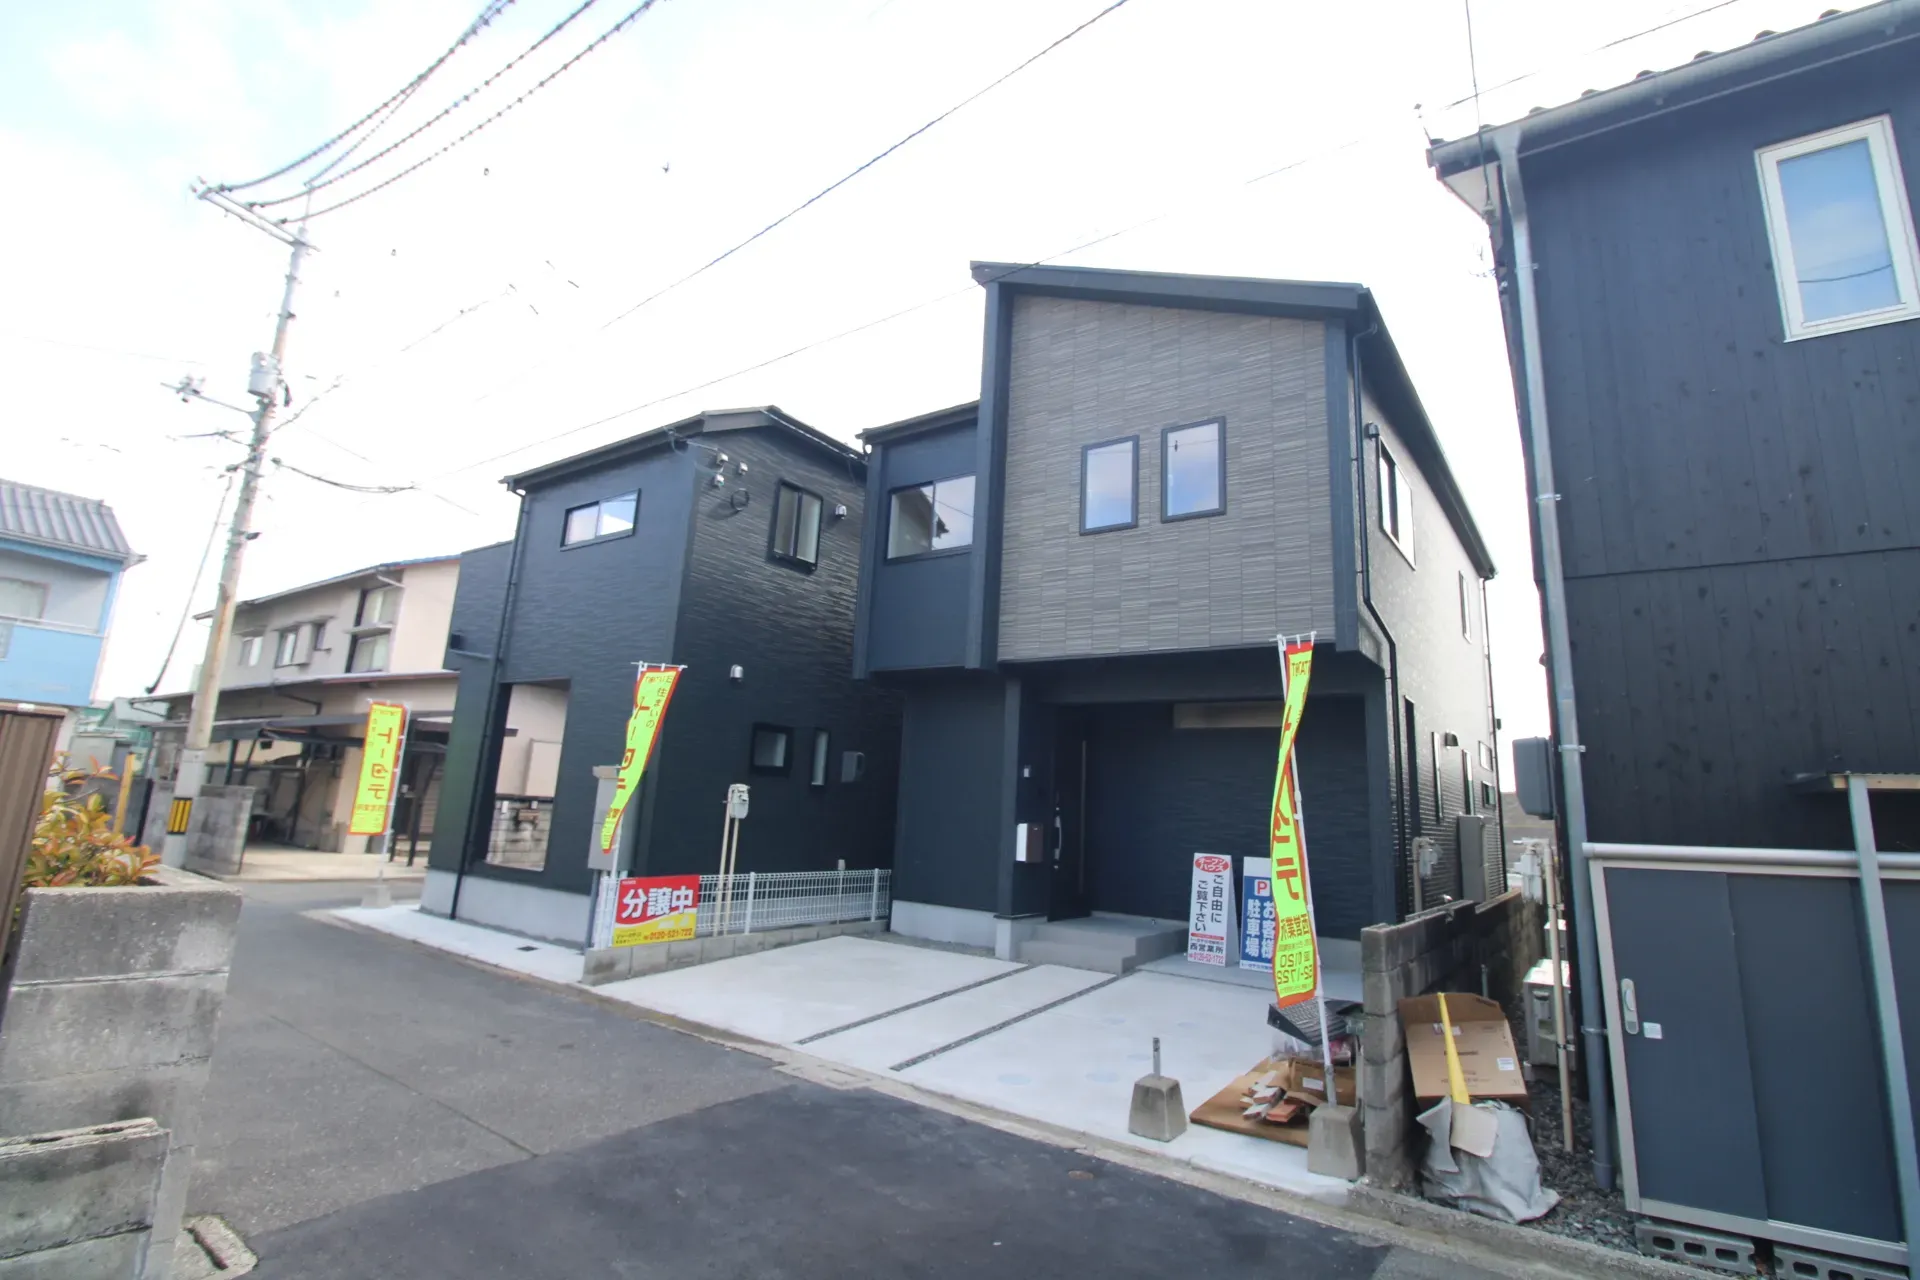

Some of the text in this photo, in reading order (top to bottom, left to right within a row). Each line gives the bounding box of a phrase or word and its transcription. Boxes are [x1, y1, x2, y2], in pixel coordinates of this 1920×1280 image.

[645, 687, 668, 729] 住まいの
[621, 885, 694, 919] 分譲中
[1195, 880, 1209, 931] ご覧下さい
[1211, 874, 1224, 923] ご自由に
[1257, 881, 1268, 894] P
[1190, 943, 1224, 955] 西営業所
[1245, 898, 1261, 957] 駐車場
[1261, 900, 1276, 959] お客様
